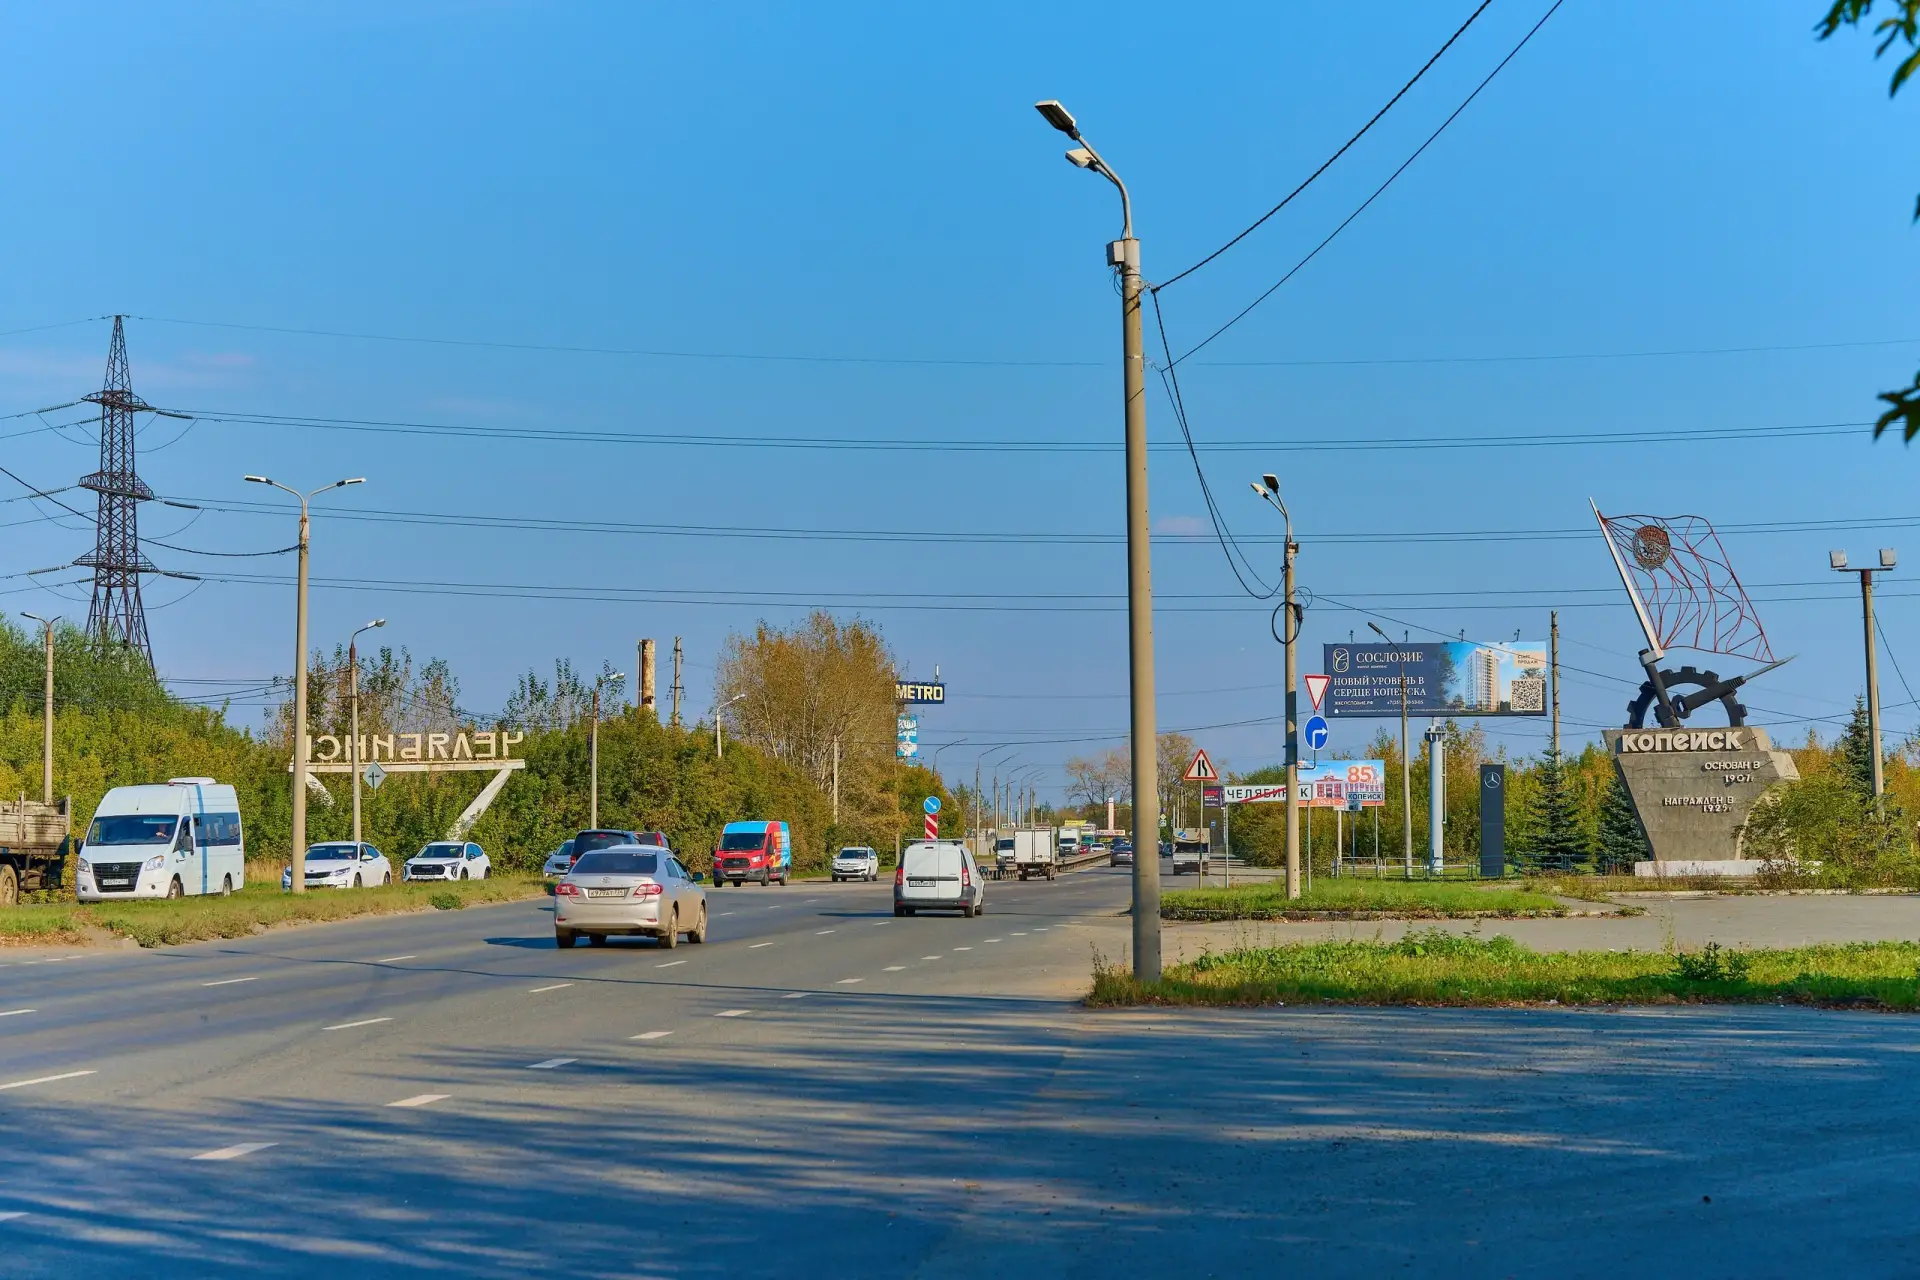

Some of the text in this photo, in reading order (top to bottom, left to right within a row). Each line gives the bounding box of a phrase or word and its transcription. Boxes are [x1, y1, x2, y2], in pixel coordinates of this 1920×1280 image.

[1356, 651, 1424, 663] СОСЛОВИЕ
[1334, 674, 1369, 686] НОВЫЙ
[1418, 676, 1425, 684] В
[895, 685, 943, 701] METRO
[1334, 688, 1371, 697] СЕРДЦЕ
[1704, 760, 1761, 770] ОСНОВАН В
[1347, 765, 1372, 783] 85
[1227, 787, 1309, 799] ЧЕЛЯБИНК
[1664, 796, 1735, 806] НАГРАЖДЕН В
